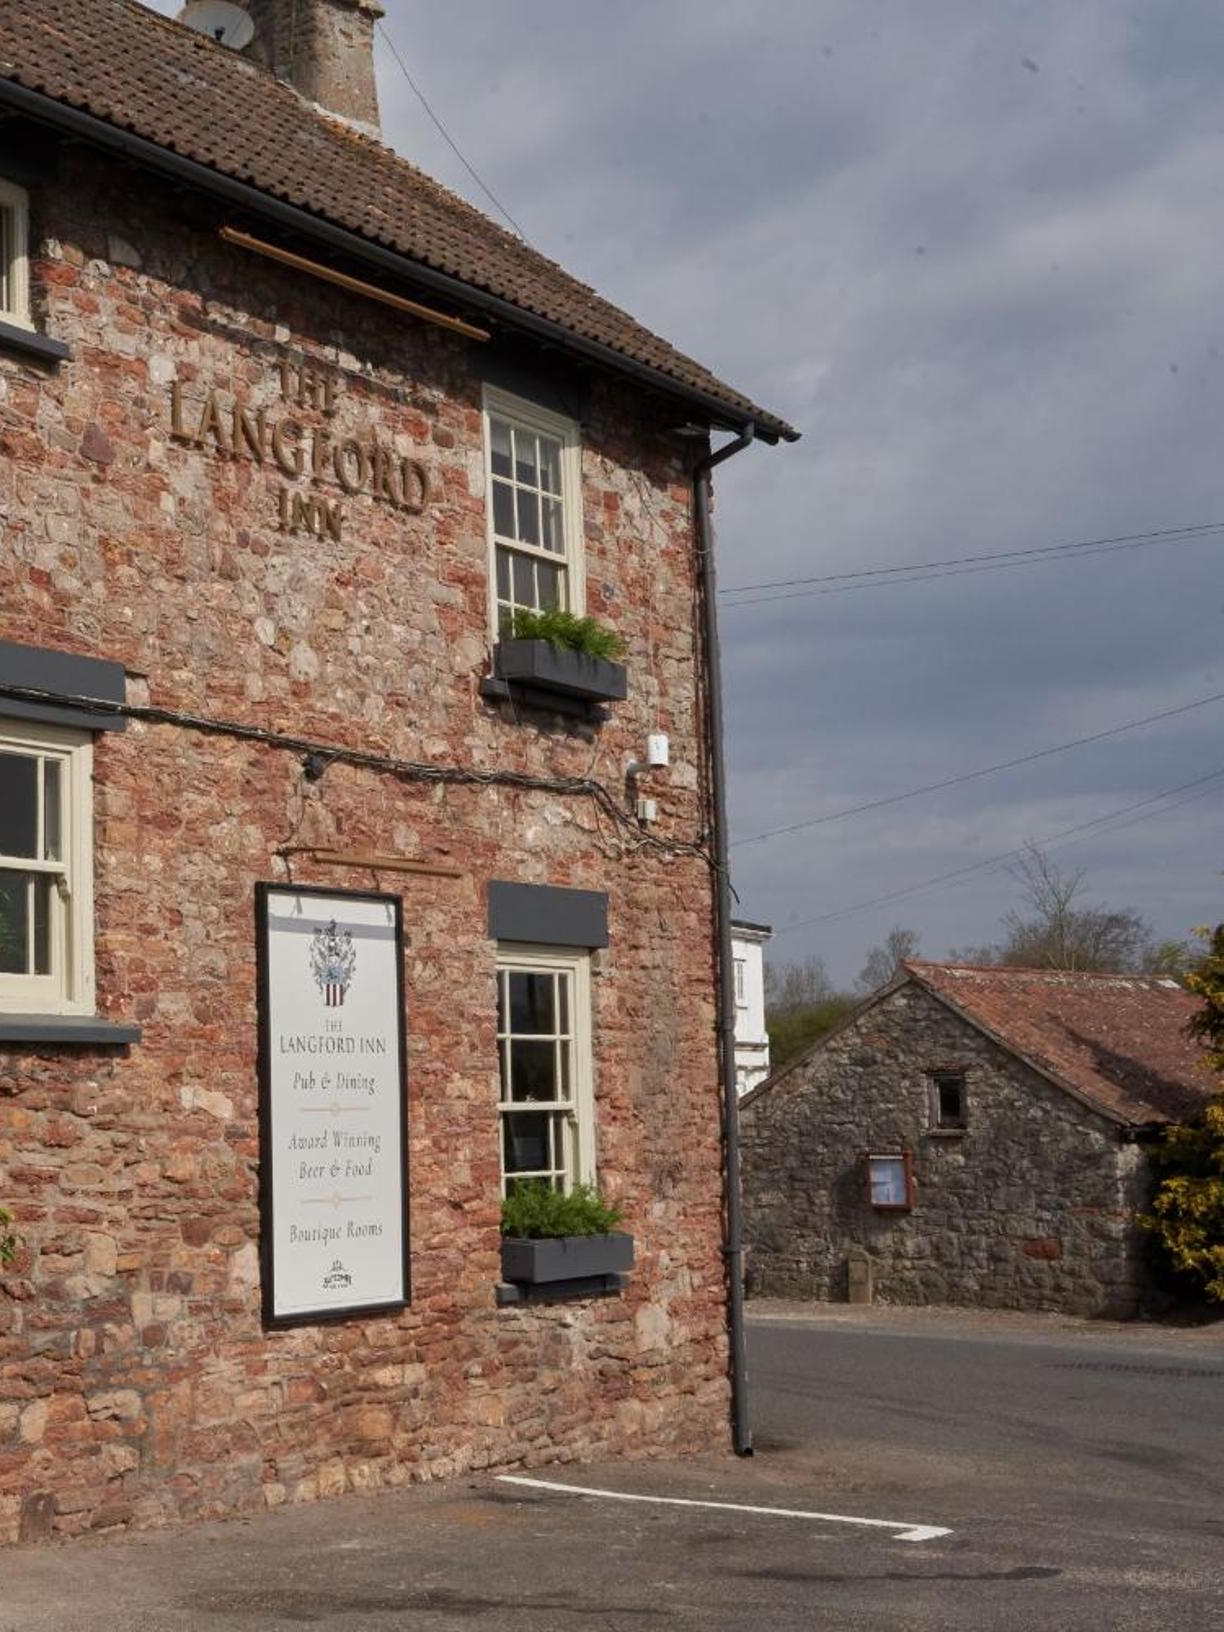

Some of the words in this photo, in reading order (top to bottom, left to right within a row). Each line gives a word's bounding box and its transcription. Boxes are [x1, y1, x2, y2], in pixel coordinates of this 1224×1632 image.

[279, 363, 338, 417] THE
[169, 380, 432, 515] LANGFORD
[279, 487, 343, 542] INN
[325, 1020, 343, 1032] THE
[279, 1036, 356, 1054] LANGFORD
[359, 1037, 387, 1054] INN
[293, 1071, 316, 1090] Pub
[321, 1073, 331, 1090] &
[337, 1072, 376, 1095] Dining
[288, 1130, 328, 1150] Award
[332, 1130, 382, 1153] Winning
[299, 1161, 324, 1179] Beer
[329, 1162, 340, 1178] &
[345, 1158, 373, 1177] Food
[289, 1223, 341, 1247] Boutique
[347, 1219, 383, 1238] Rooms
